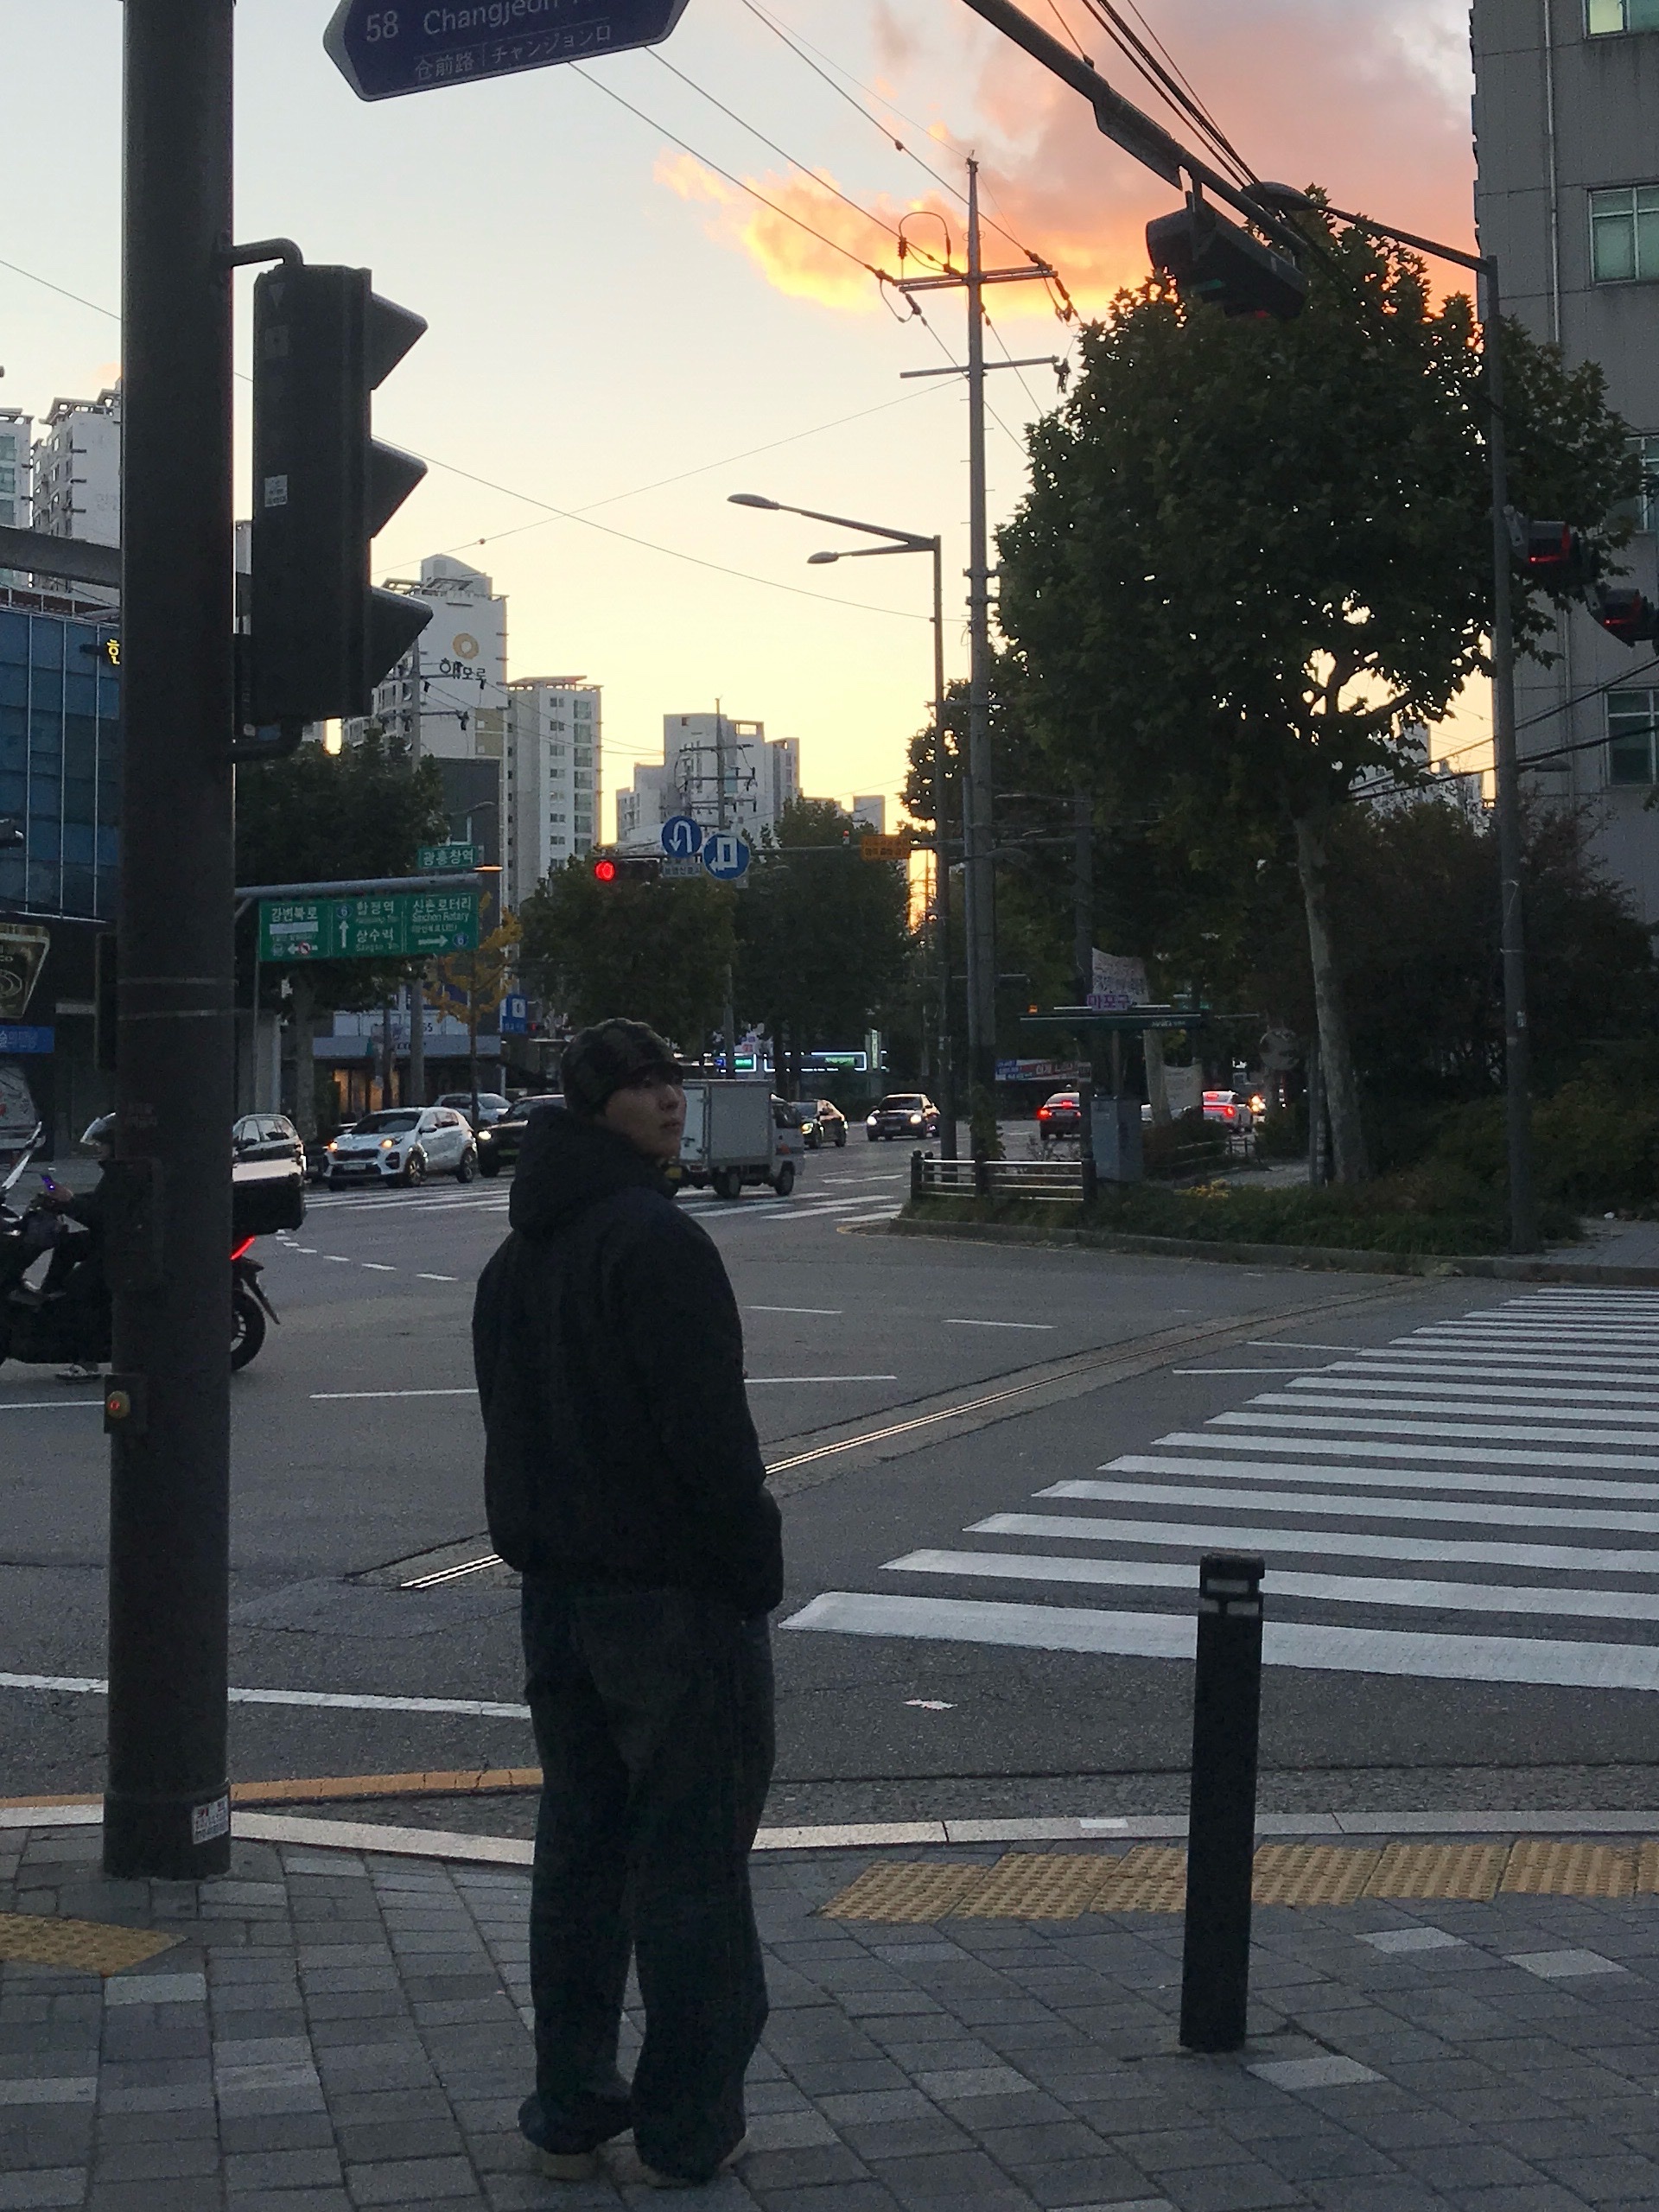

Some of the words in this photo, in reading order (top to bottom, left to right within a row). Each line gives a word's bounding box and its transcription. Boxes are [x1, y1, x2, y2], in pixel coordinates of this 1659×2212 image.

[366, 10, 398, 41] 58
[440, 658, 486, 680] 해모로
[1087, 994, 1129, 1009] 마포구
